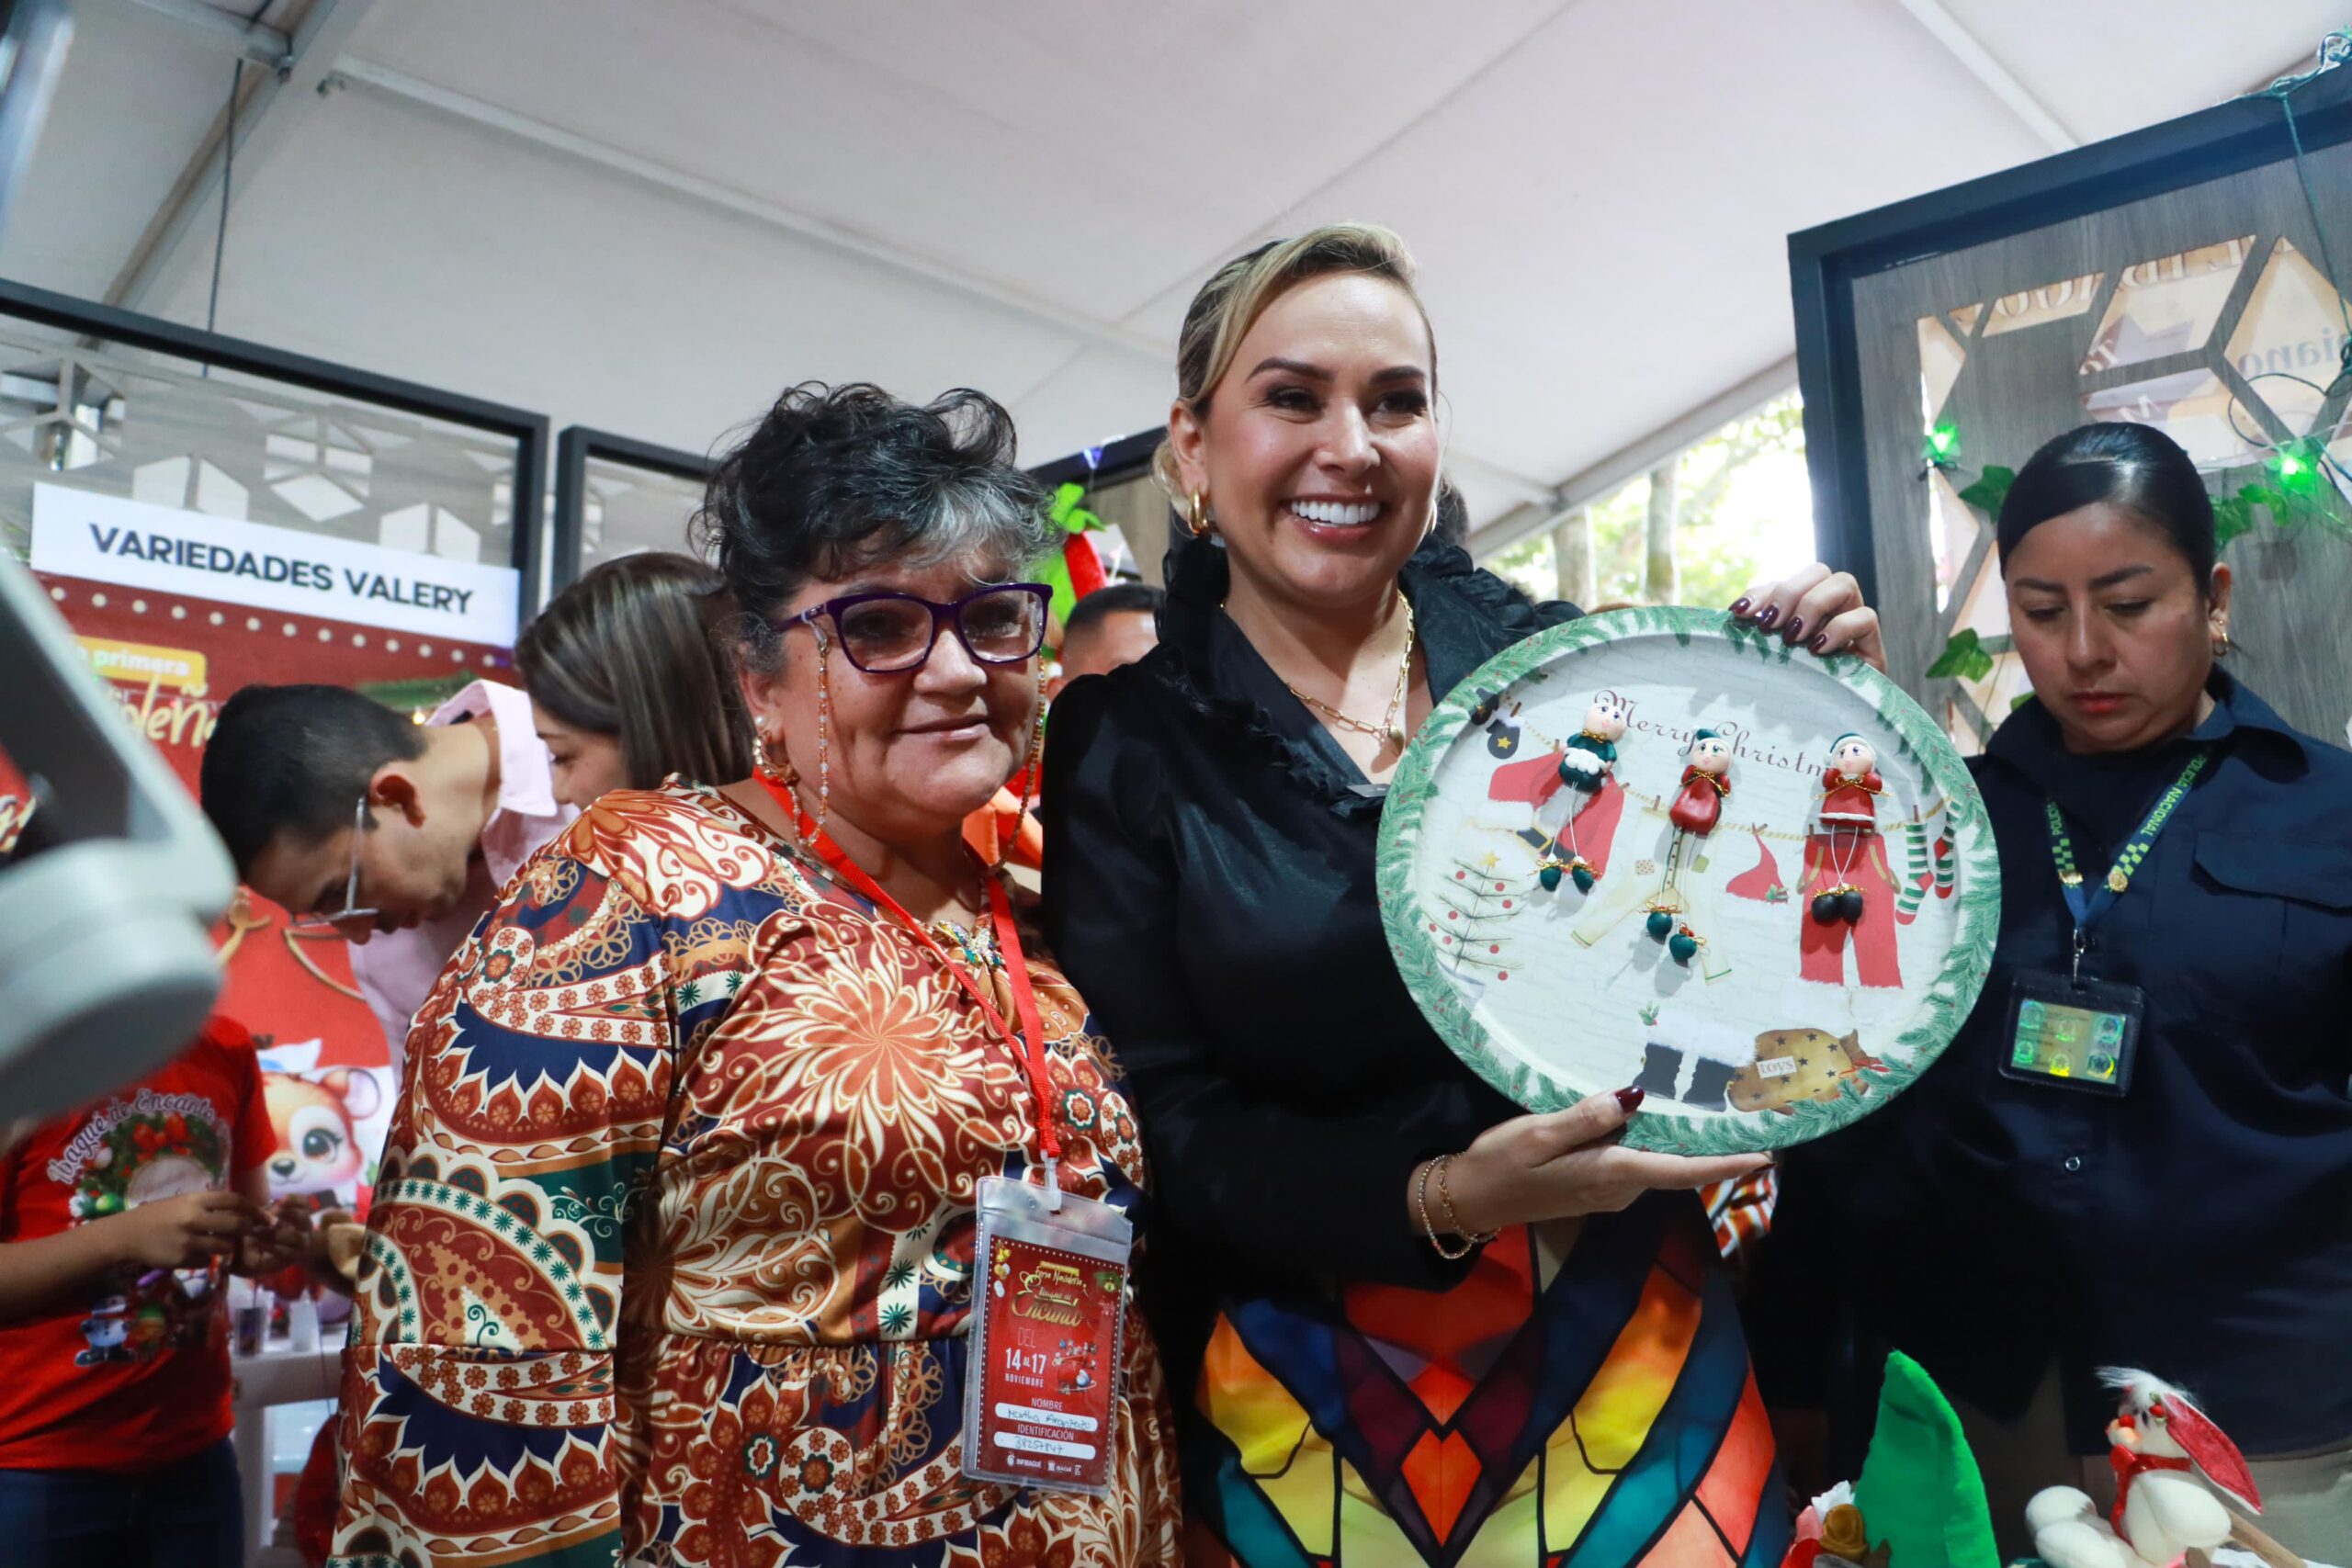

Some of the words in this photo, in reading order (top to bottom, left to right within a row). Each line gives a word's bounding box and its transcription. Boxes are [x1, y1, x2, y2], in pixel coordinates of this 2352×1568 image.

[89, 524, 333, 591] VARIEDADES
[344, 568, 475, 615] VALERY
[94, 649, 189, 676] primera
[2140, 787, 2184, 837] NACIONAL
[1758, 1059, 1794, 1074] toys
[108, 1097, 133, 1126] de
[135, 1088, 216, 1123] Encanto
[1017, 1326, 1036, 1348] DEL
[1005, 1347, 1022, 1371] 14
[1023, 1356, 1031, 1368] AL
[1032, 1352, 1047, 1375] 17
[1004, 1372, 1045, 1389] NOVIEMBRE
[1031, 1397, 1064, 1412] NOMBRE
[1017, 1423, 1075, 1441] IDENTIFICACIÓN
